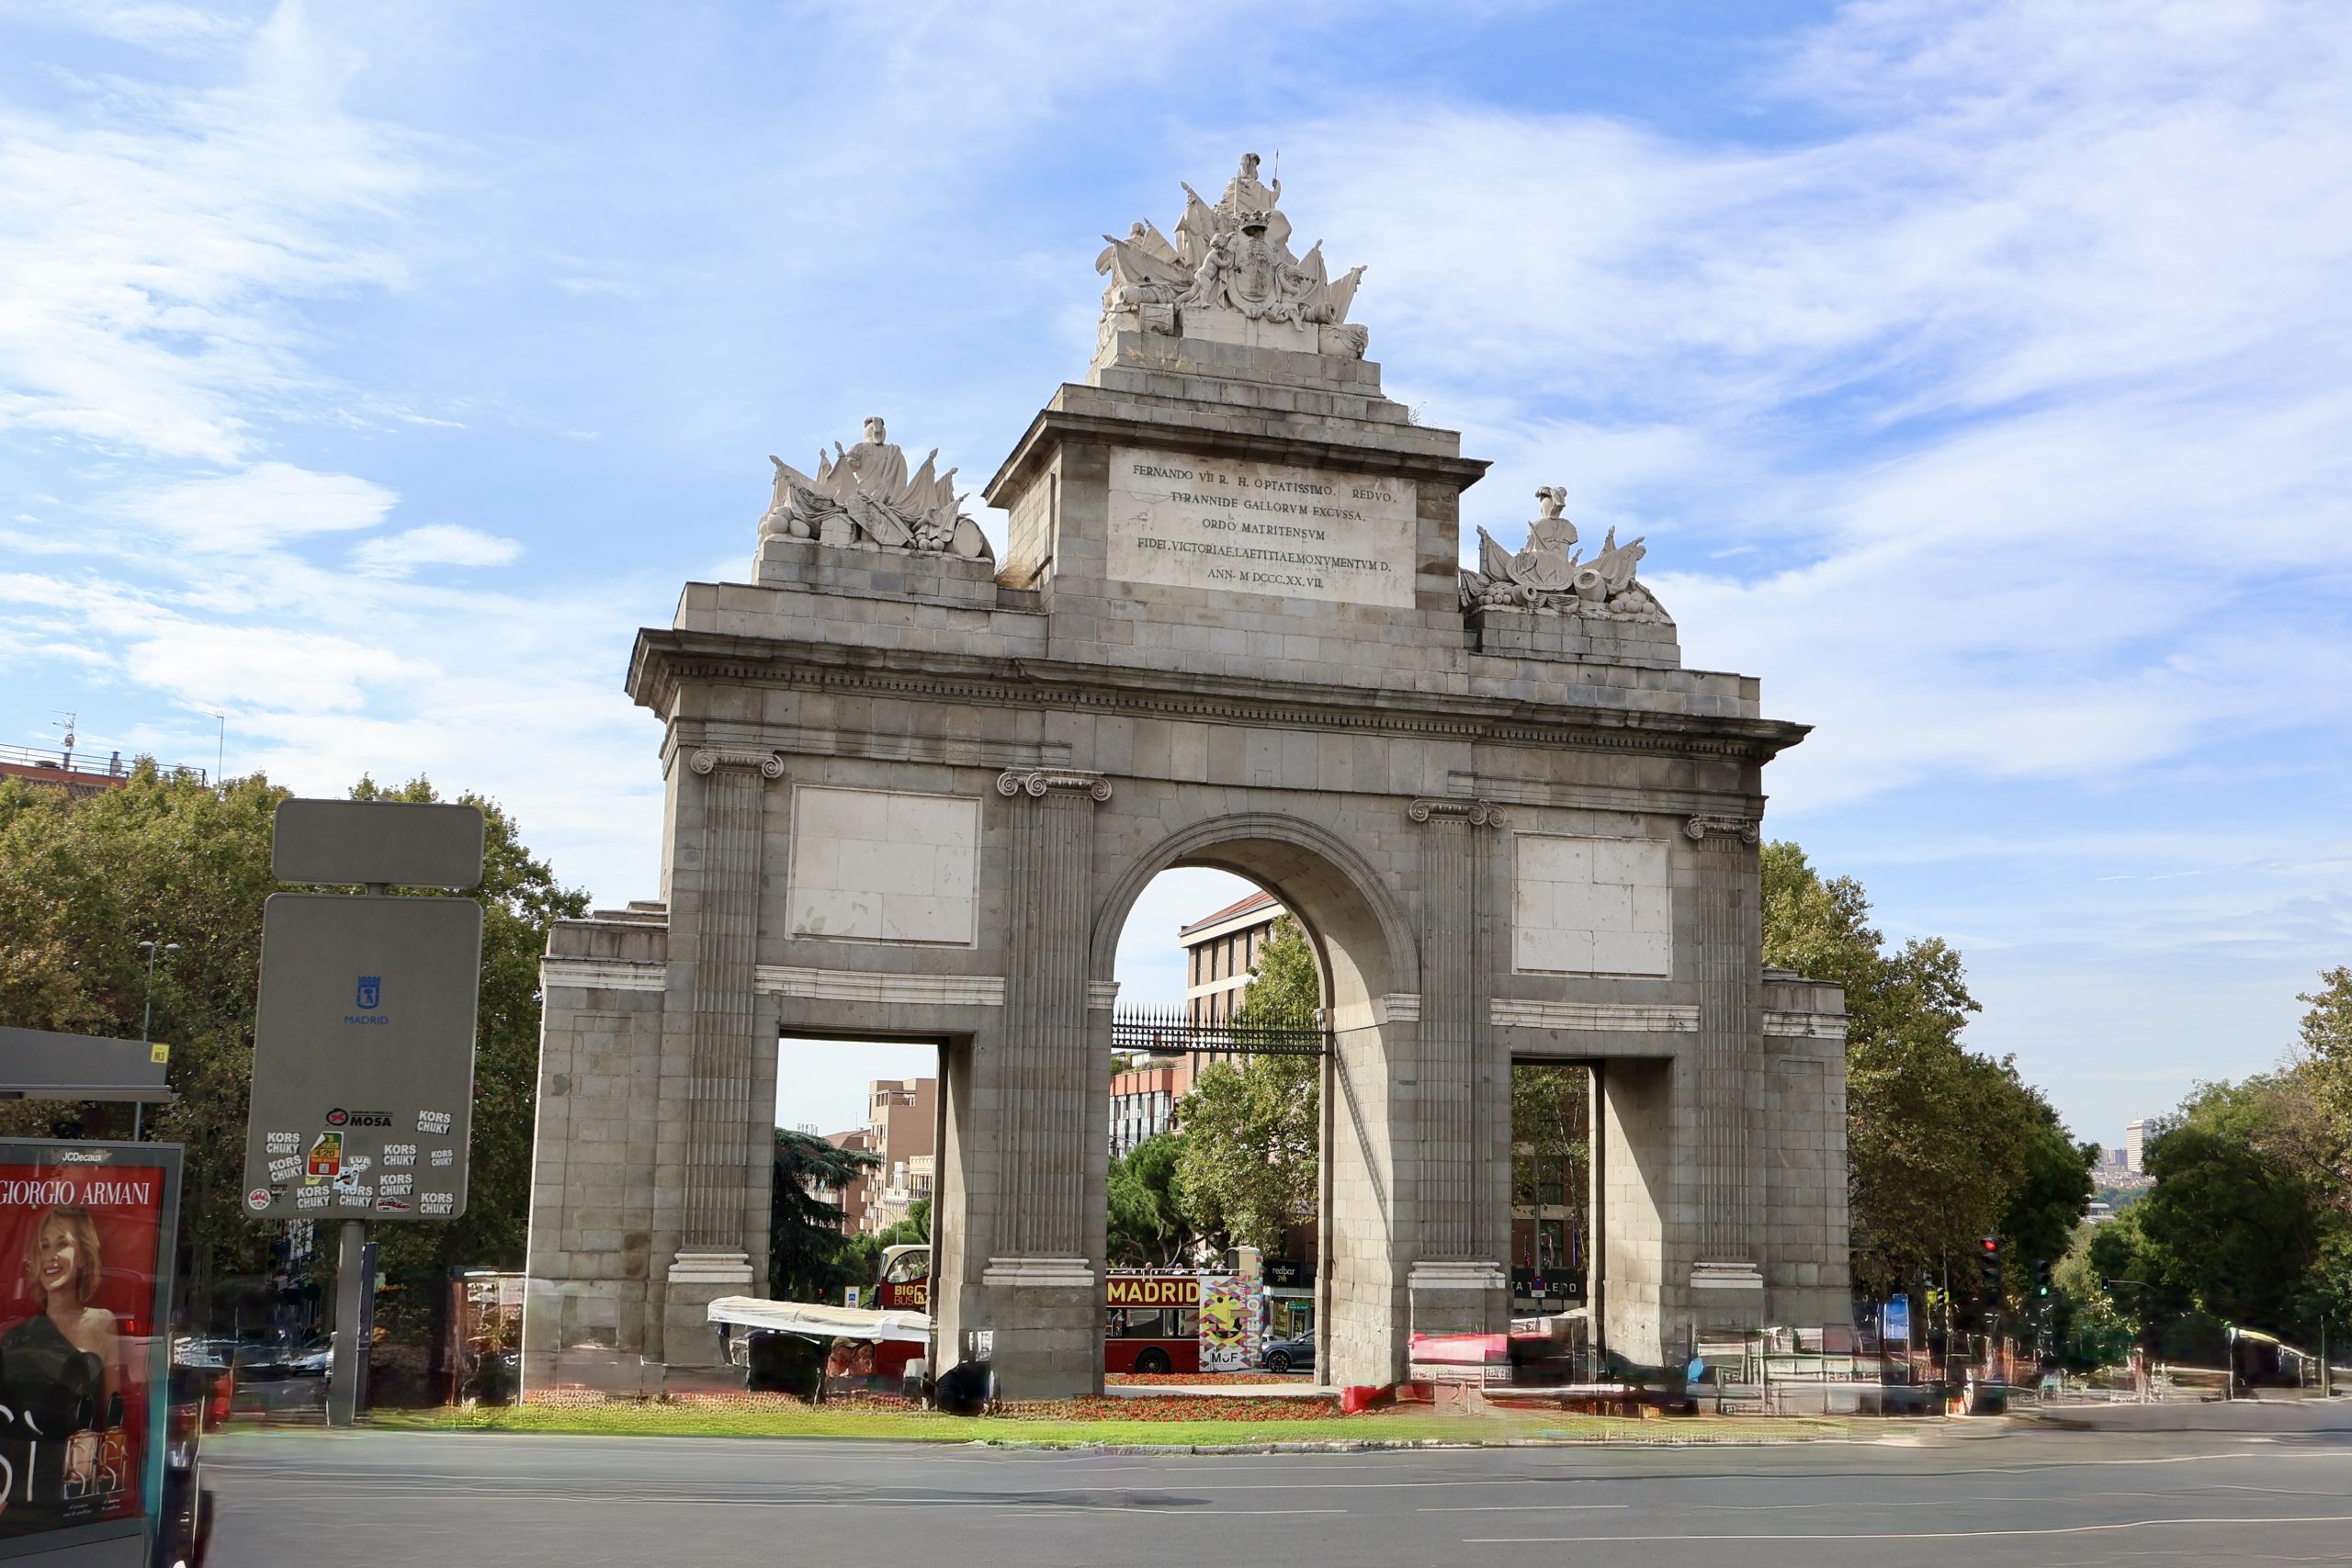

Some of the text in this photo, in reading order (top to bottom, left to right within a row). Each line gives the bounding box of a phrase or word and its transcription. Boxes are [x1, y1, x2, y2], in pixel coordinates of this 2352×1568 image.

[1133, 464, 1193, 479] FERNANDO
[1199, 470, 1214, 483] VII
[1219, 474, 1228, 485] R.
[1238, 477, 1249, 488] H.
[1254, 479, 1337, 496] OPTATISSIMO.
[1170, 491, 1366, 522] TYRANNIDE GALLORVM EXCVSSA.
[1202, 518, 1326, 541] ORDO MATRITENSVM
[1380, 561, 1392, 572] D.
[344, 1015, 389, 1026] MADRID
[153, 1051, 164, 1062] M3
[349, 1116, 391, 1127] MOSA
[419, 1110, 451, 1123] KORS
[417, 1121, 450, 1134] CHUKY
[266, 1132, 300, 1143] KORS
[266, 1143, 300, 1154] CHUKY
[384, 1145, 416, 1155] KORS
[431, 1149, 453, 1158] KORS
[62, 1152, 102, 1162] JCDecaux
[383, 1155, 416, 1166] CHUKY
[431, 1157, 453, 1167] CHUKY
[267, 1155, 302, 1172] KORS
[270, 1165, 303, 1182] CHUKY
[379, 1174, 413, 1185] KORS
[0, 1179, 151, 1205] GIORGIO ARMANI
[297, 1185, 330, 1198] KORS
[379, 1184, 413, 1196] CHUKY
[297, 1196, 330, 1209] CHUKY
[339, 1195, 372, 1207] CHUKY
[421, 1192, 454, 1203] KORS
[420, 1203, 453, 1214] CHUKY
[1272, 1265, 1296, 1276] redbar
[894, 1285, 914, 1296] BIG
[1106, 1281, 1200, 1303] MADRID
[894, 1295, 914, 1305] BUS
